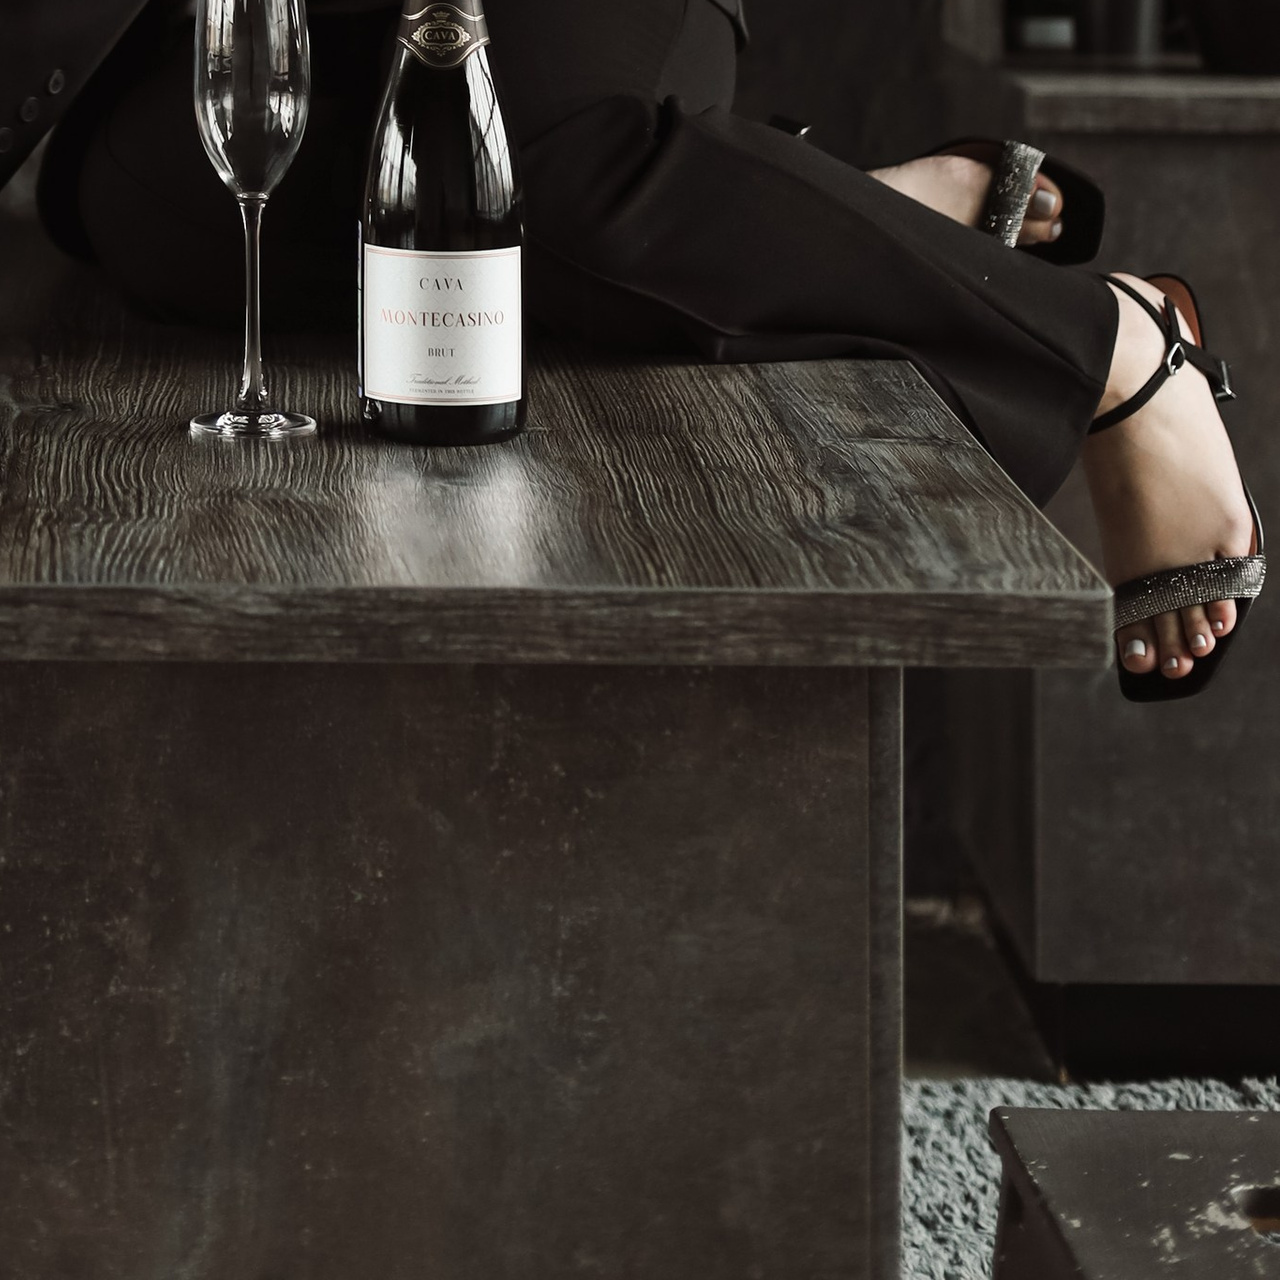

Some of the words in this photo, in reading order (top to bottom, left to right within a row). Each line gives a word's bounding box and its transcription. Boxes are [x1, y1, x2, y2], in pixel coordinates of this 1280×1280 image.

[424, 30, 456, 40] CAVA
[419, 278, 464, 291] CAVA
[381, 308, 504, 327] MONTECASINO
[427, 347, 456, 358] BRUT
